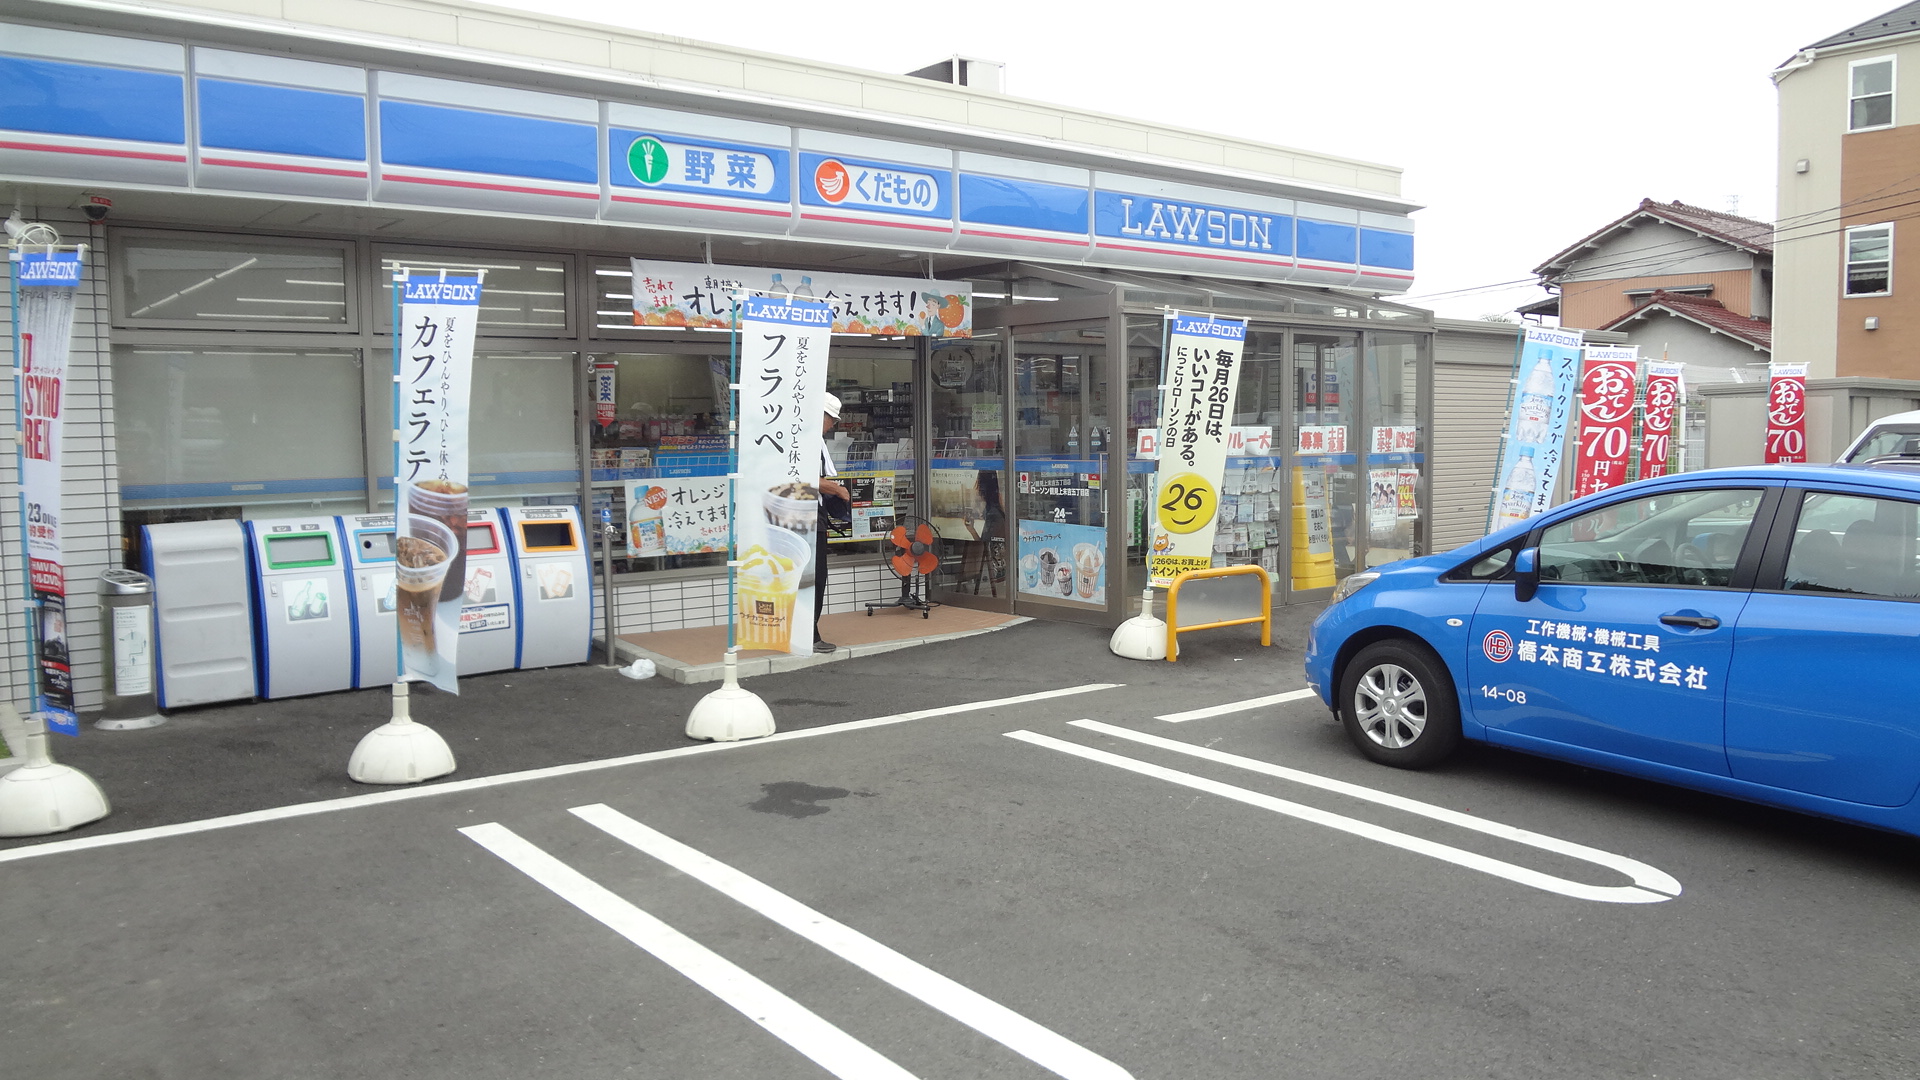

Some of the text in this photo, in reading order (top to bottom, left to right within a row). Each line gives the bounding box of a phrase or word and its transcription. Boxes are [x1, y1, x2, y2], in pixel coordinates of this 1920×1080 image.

[684, 149, 757, 189] 野菜
[855, 169, 930, 208] くだもの
[1120, 199, 1273, 250] LAWSON
[20, 261, 78, 280] LAWSON
[642, 276, 675, 293] 売れて
[405, 283, 478, 300] LAWSON
[747, 302, 830, 324] LAWSON
[1175, 320, 1243, 338] LAWSON
[1528, 330, 1579, 347] LAWSON
[1589, 350, 1633, 359] LAWSON
[1650, 366, 1679, 375] LAWSON
[406, 315, 438, 482] カフェラテ
[438, 316, 456, 487] 夏をひんやり、ひと休み。
[754, 333, 787, 454] フラッペ
[787, 336, 810, 484] 夏をひんやり、ひと休み。
[1165, 346, 1188, 448] にっこりローソンの日
[1180, 347, 1210, 467] いいコトがある。
[1205, 349, 1234, 444] 毎月26日は、
[1551, 357, 1574, 445] スパークリング
[1582, 367, 1629, 420] おでん
[1645, 381, 1676, 429] おでん
[1769, 382, 1801, 424] おでん
[1301, 431, 1323, 450] 募集
[1583, 426, 1628, 459] 70
[1644, 434, 1670, 462] 70
[1767, 429, 1804, 454] 70
[643, 488, 668, 507] NEW
[671, 483, 725, 506] オレンジ
[1161, 483, 1208, 512] 26
[1525, 619, 1660, 653] 工作機械・機械工具
[1517, 639, 1709, 691] 橋本商工株式会社
[1481, 684, 1527, 705] 14-08
